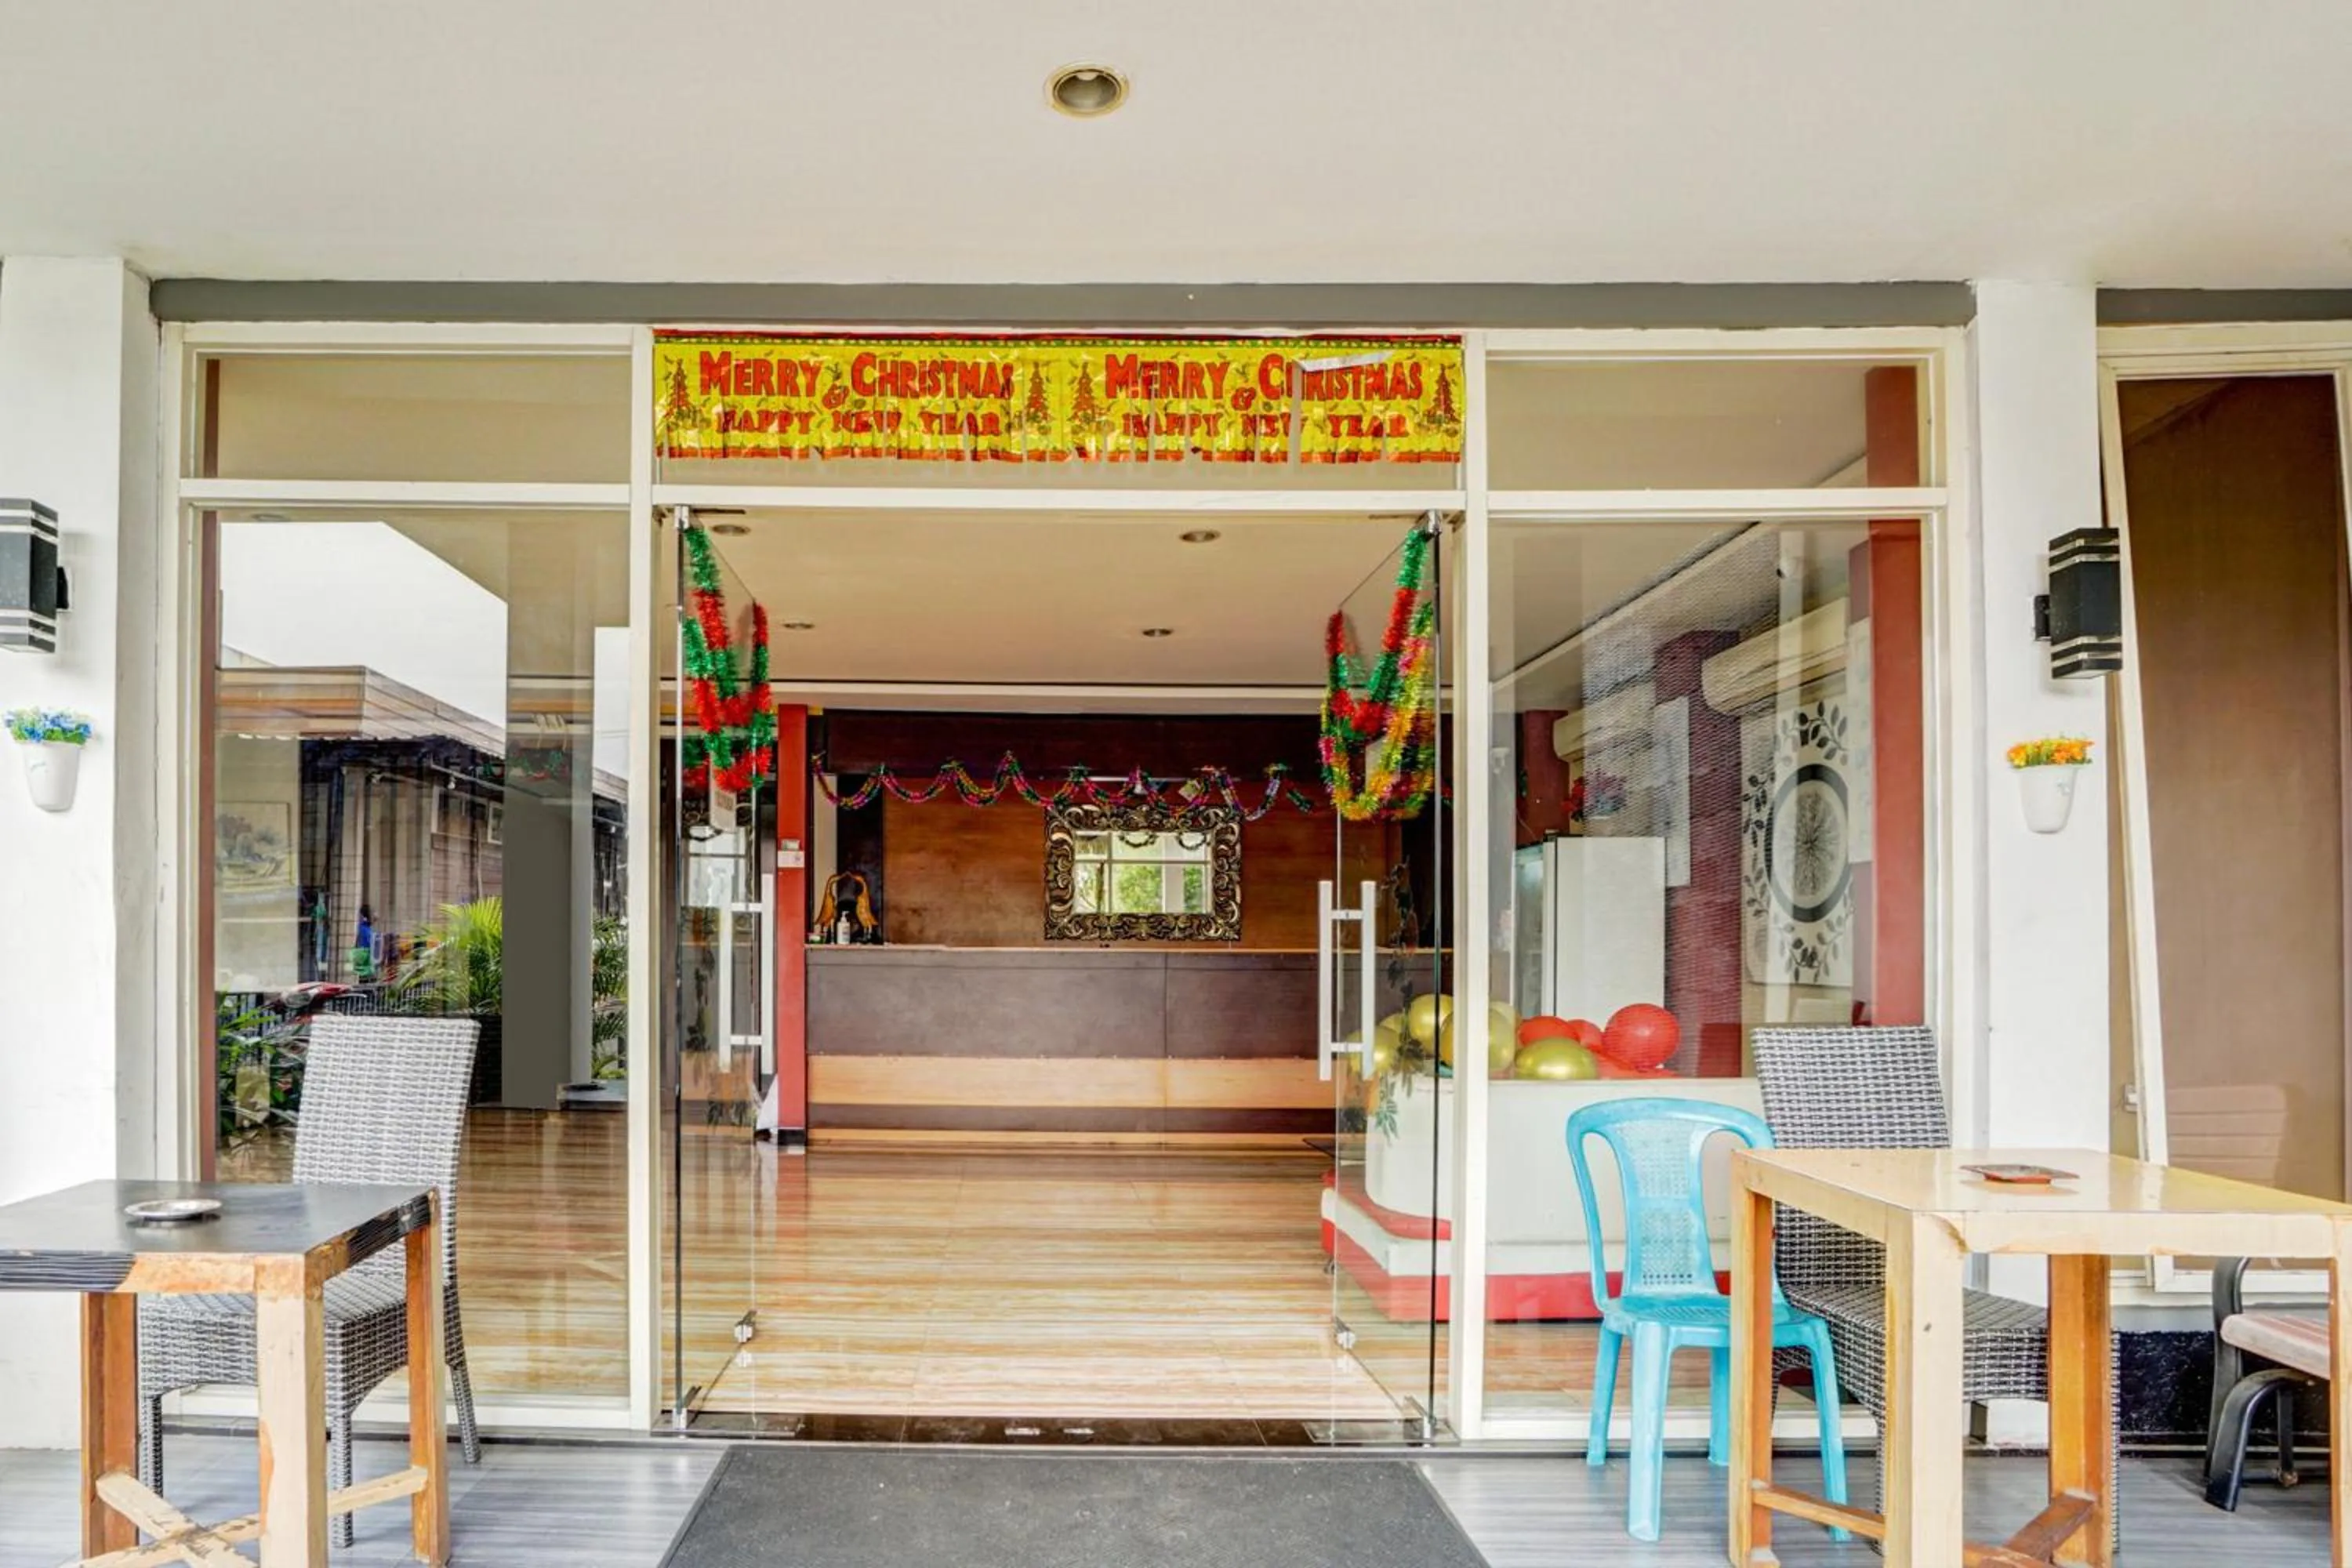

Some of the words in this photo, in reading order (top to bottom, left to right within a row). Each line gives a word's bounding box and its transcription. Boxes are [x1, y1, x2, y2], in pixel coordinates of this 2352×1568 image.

[699, 350, 822, 397] MERRY
[851, 352, 1014, 400] CHRISTMAS
[1105, 354, 1230, 400] MERRY
[1231, 387, 1256, 411] &
[716, 408, 815, 434] HAPPY
[832, 410, 902, 434] NEW
[919, 410, 1002, 436] YEAR
[1328, 414, 1410, 438] YEAR
